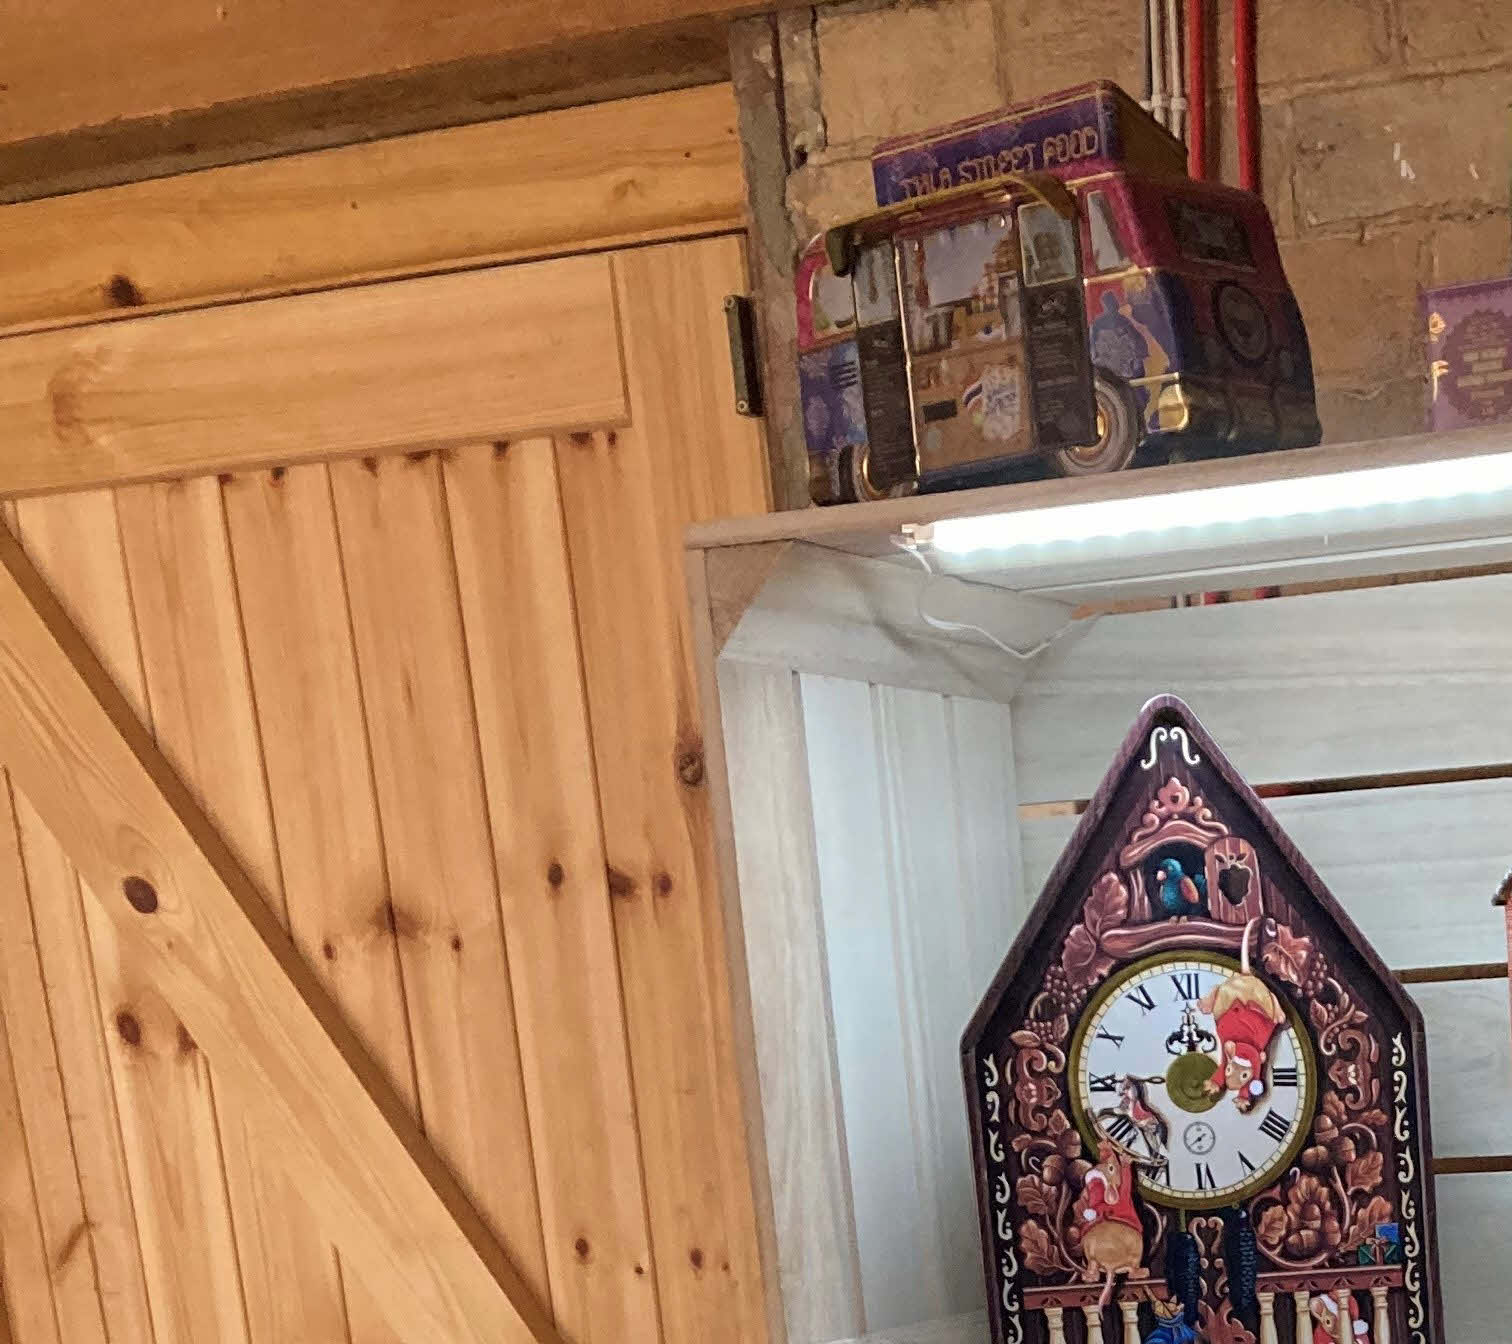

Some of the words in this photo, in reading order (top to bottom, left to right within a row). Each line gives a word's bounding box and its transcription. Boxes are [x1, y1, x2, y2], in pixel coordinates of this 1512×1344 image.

[1042, 126, 1099, 169] FOOD
[1170, 973, 1201, 1001] XII
[1096, 1024, 1125, 1049] X
